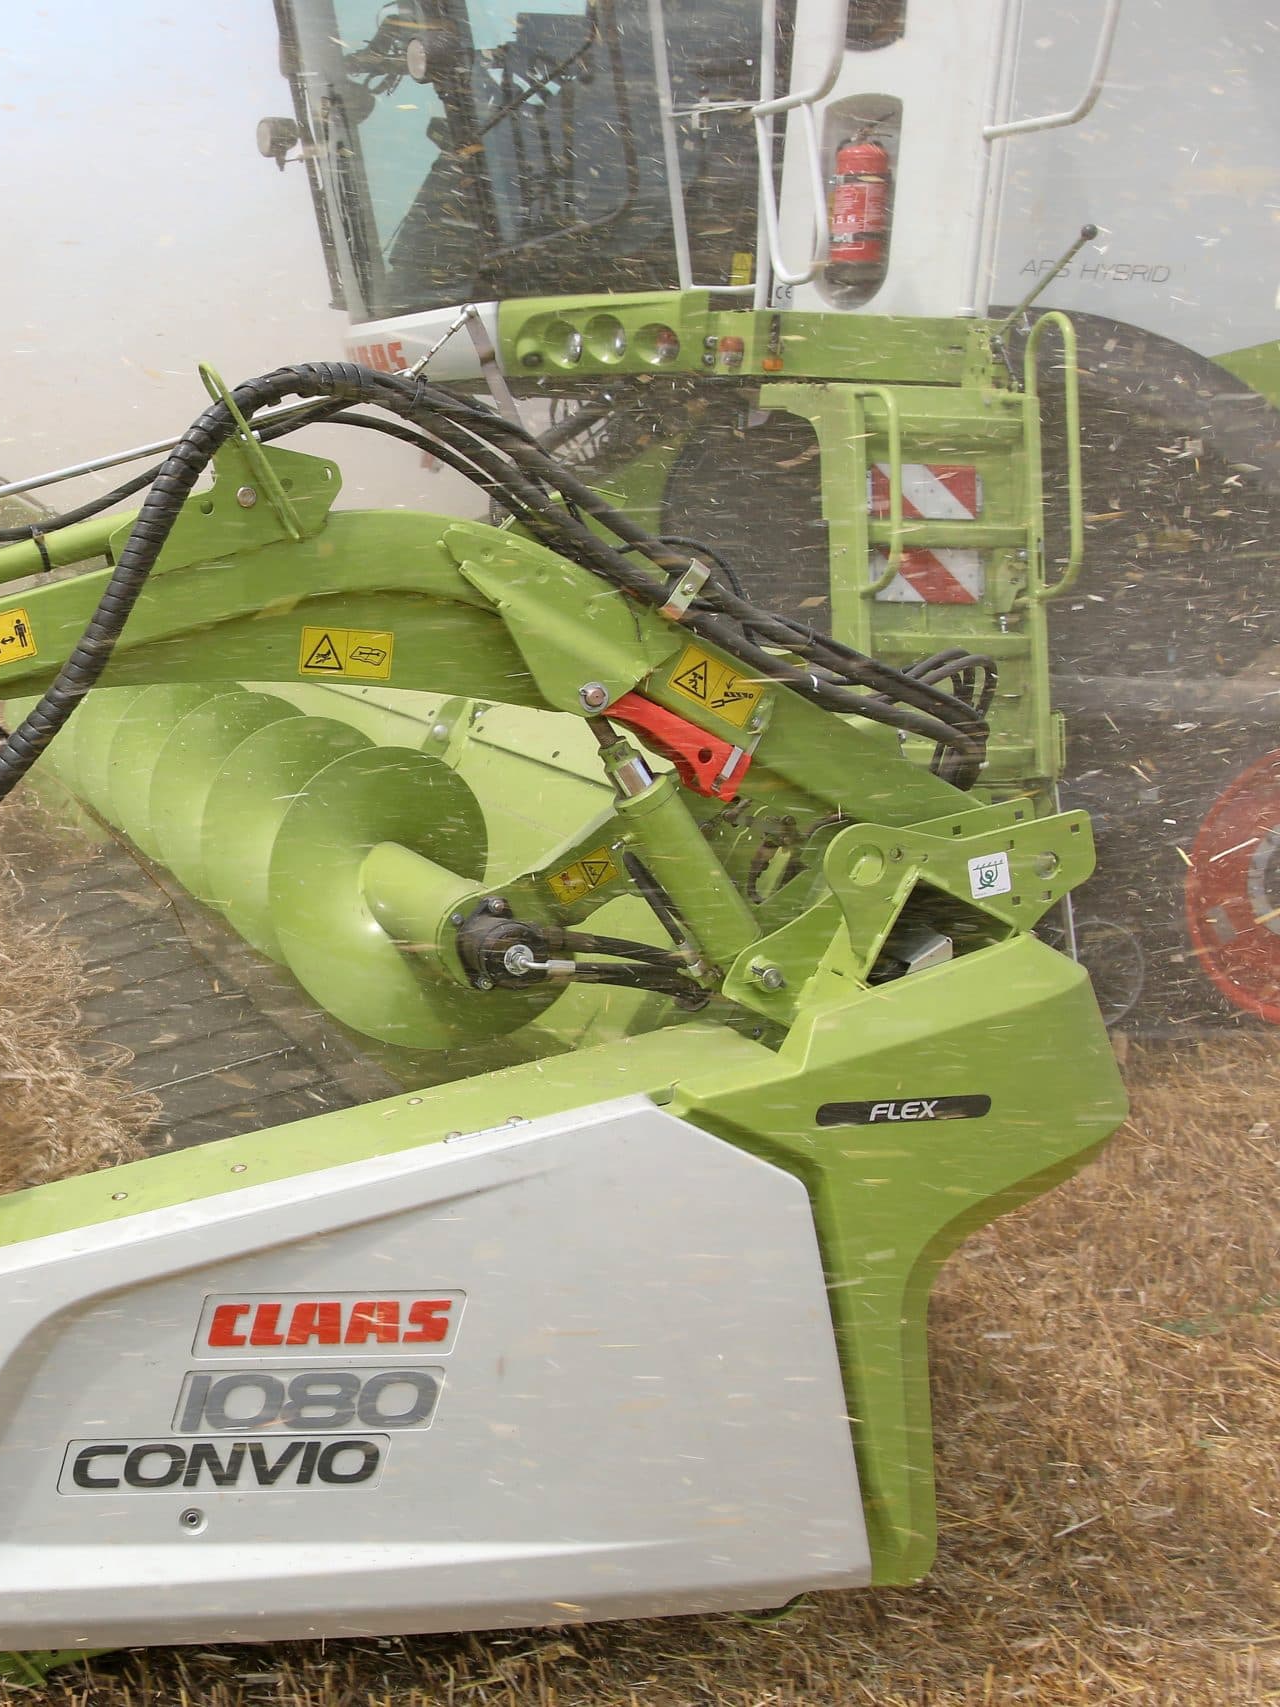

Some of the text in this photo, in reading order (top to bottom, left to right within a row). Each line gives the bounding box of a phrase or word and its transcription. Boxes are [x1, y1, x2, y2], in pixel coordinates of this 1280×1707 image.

[1080, 262, 1170, 283] HYBRID
[869, 1100, 938, 1121] FLEX
[208, 1300, 452, 1347] CLAAS
[180, 1371, 438, 1432] 1080
[72, 1440, 380, 1488] CONVIO
